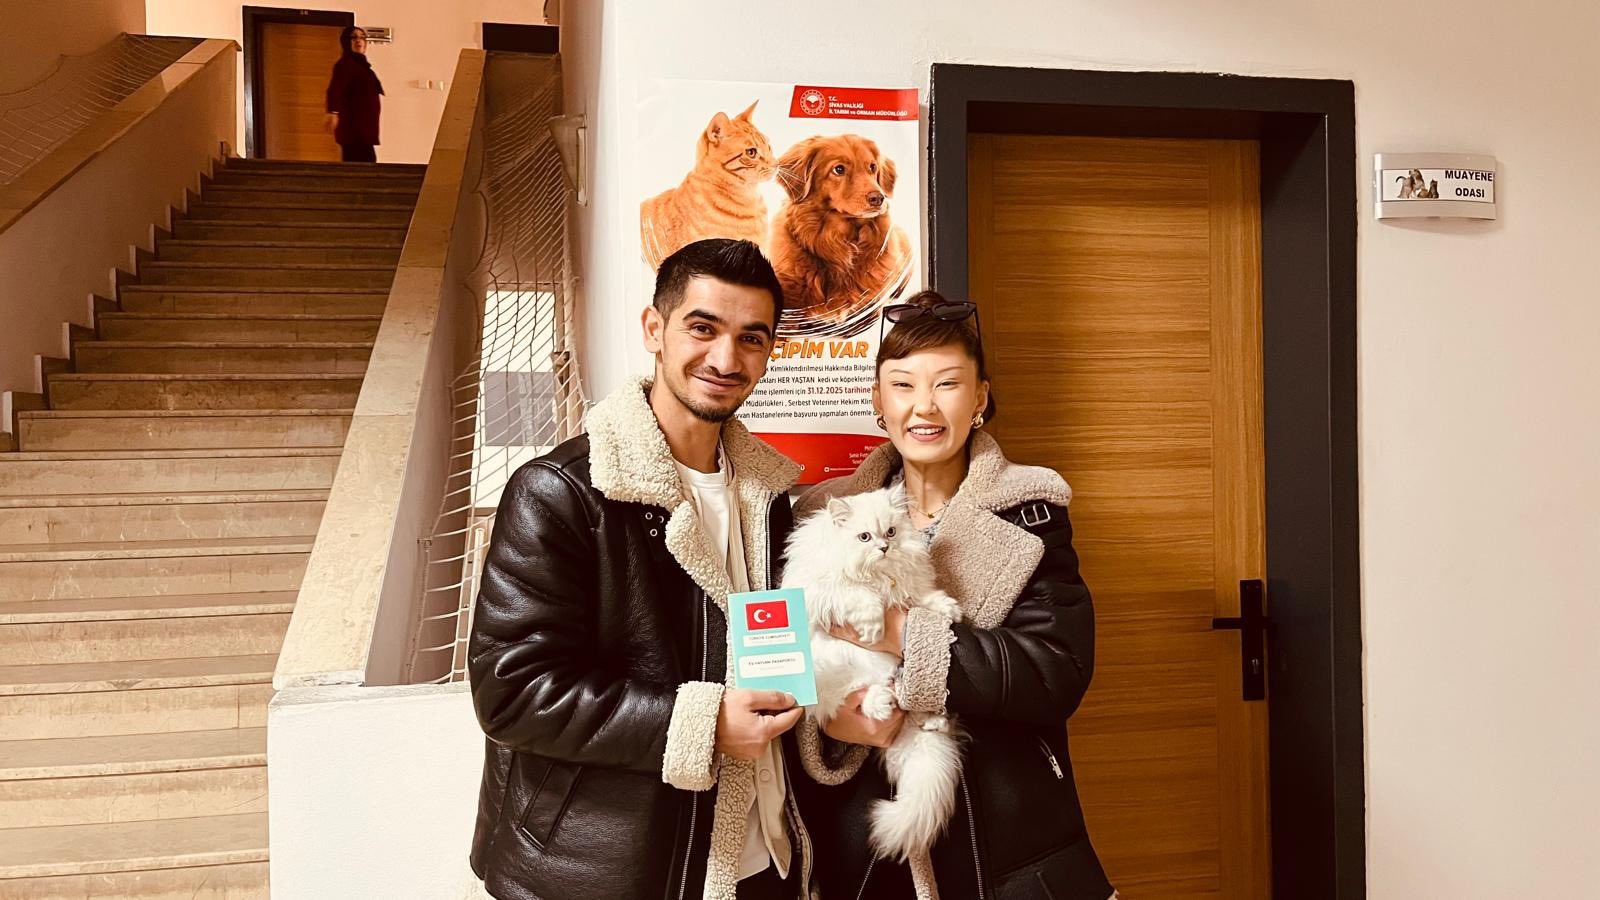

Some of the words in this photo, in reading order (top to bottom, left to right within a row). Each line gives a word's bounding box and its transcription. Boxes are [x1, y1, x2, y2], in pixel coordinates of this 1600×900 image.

[1445, 170, 1493, 182] MUAYENE
[1456, 188, 1485, 198] ODASI
[829, 341, 869, 358] VAR
